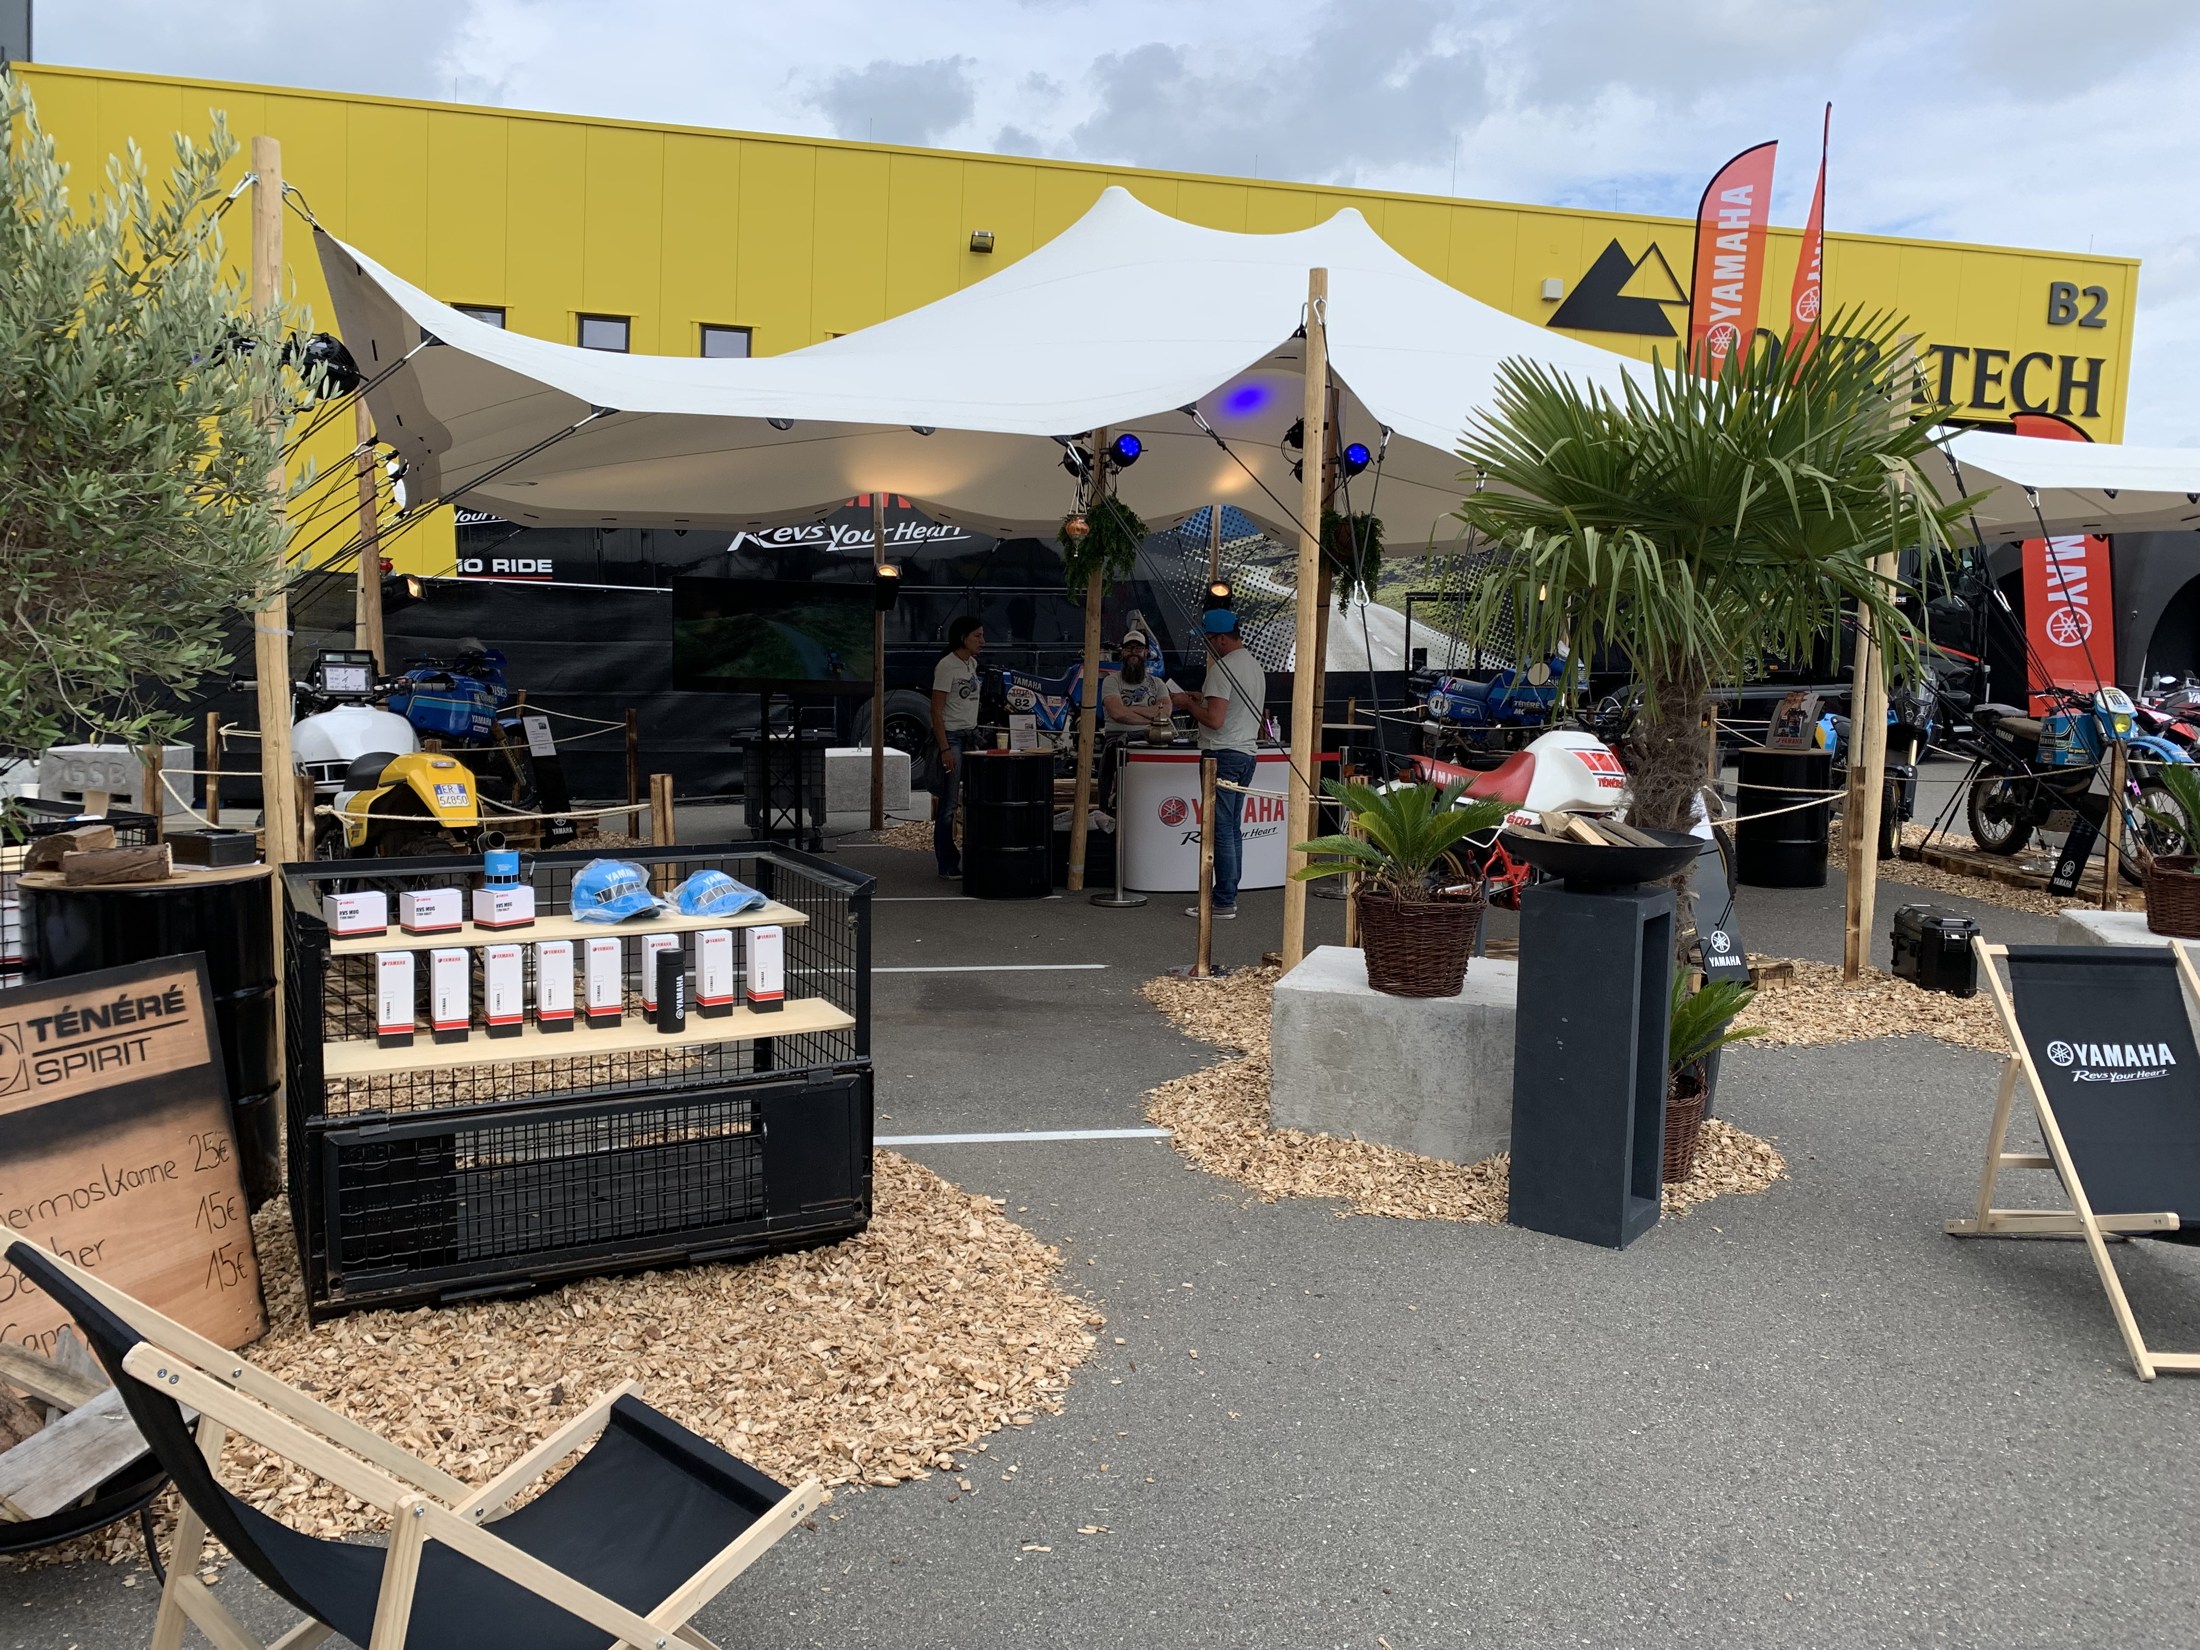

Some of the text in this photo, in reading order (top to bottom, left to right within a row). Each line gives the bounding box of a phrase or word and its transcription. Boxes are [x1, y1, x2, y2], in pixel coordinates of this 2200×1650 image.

[1709, 184, 1753, 323] YAMAHA
[2047, 281, 2109, 328] B2
[492, 558, 553, 573] RIDE
[1013, 675, 1042, 692] YAMAHA
[1014, 698, 1030, 708] 82
[63, 759, 127, 787] GSB
[1191, 797, 1285, 825] YAHA
[552, 826, 574, 836] YAMAHA
[1708, 955, 1742, 968] YAMAHA
[676, 975, 684, 1010] YAMAHA
[27, 984, 187, 1043] TÉNÉRÉ
[35, 1036, 152, 1086] SPIRIT
[2072, 1043, 2177, 1068] YAMAHA
[2071, 1069, 2169, 1083] Revs Your Heart
[0, 1131, 230, 1230] ermoskanne 25€
[0, 1190, 238, 1302] Beher 15€
[205, 1241, 249, 1293] 15€
